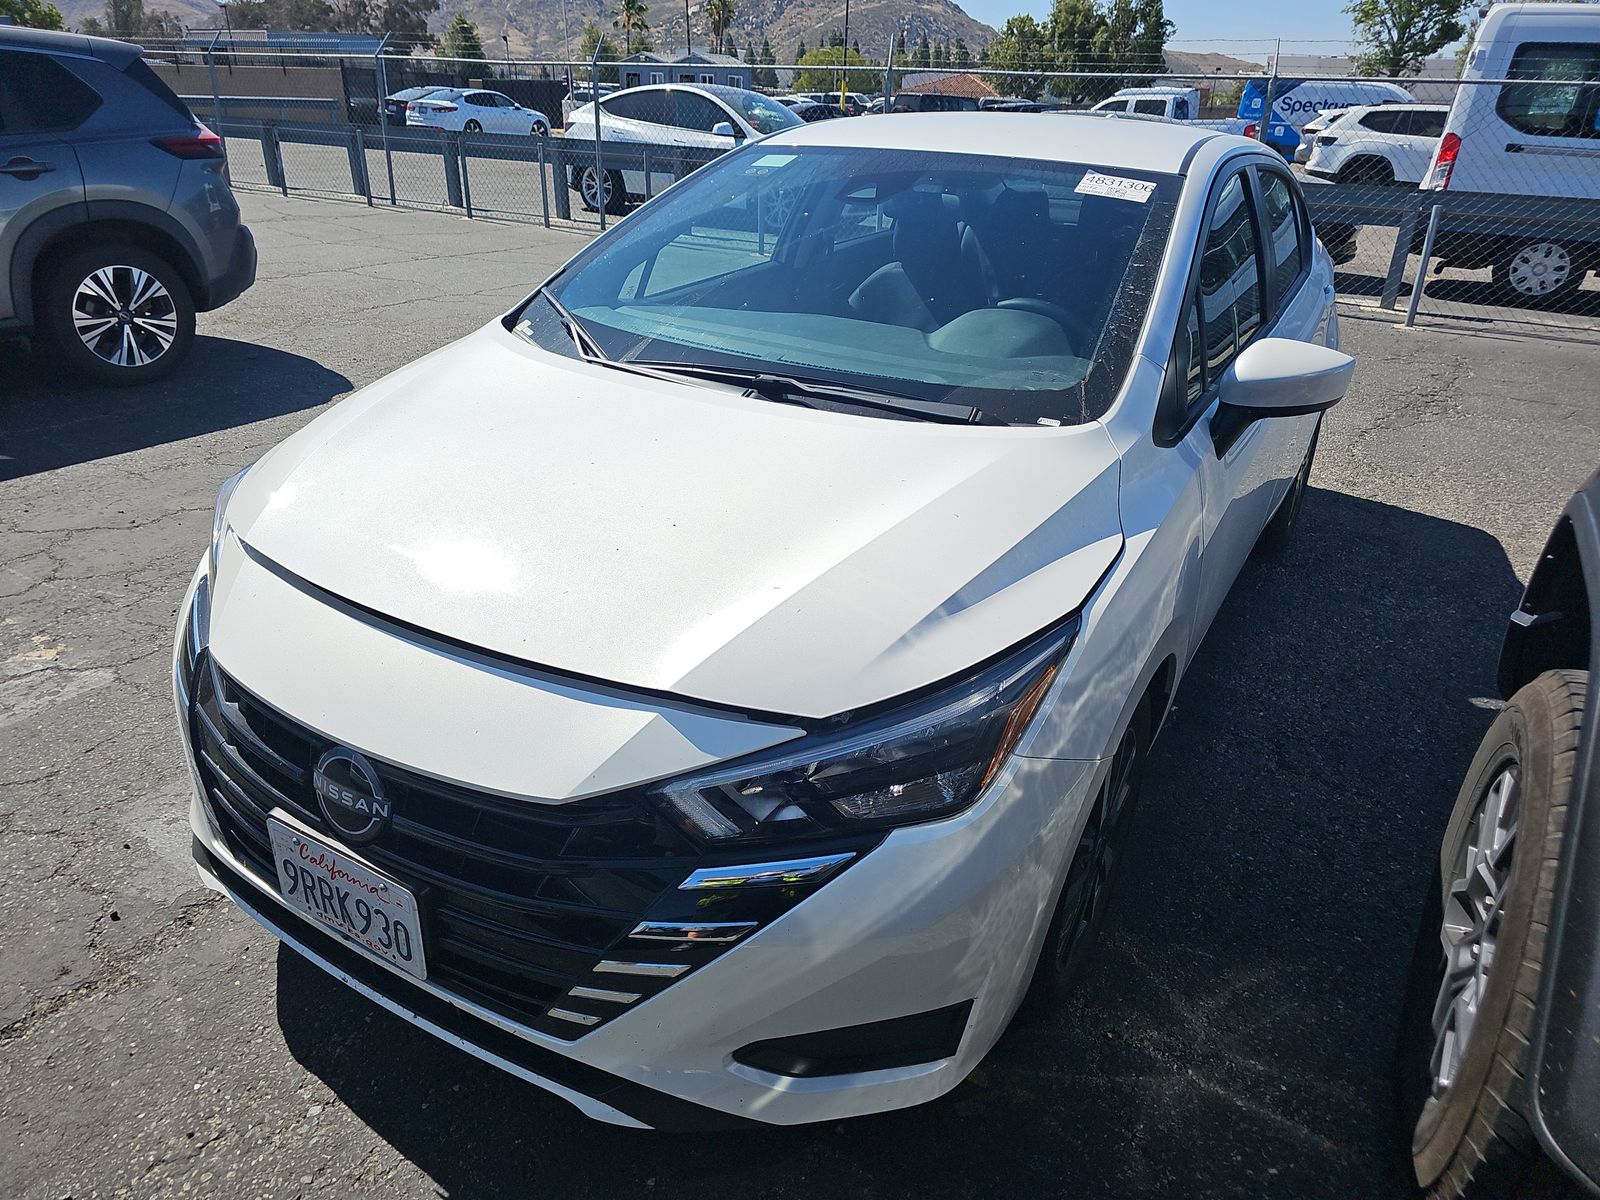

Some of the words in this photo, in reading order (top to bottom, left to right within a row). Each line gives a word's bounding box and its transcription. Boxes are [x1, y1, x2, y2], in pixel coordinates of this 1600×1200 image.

[1086, 175, 1155, 192] 4831306
[313, 775, 390, 818] NISSAN
[298, 843, 390, 903] California
[282, 859, 413, 962] 9RRK930
